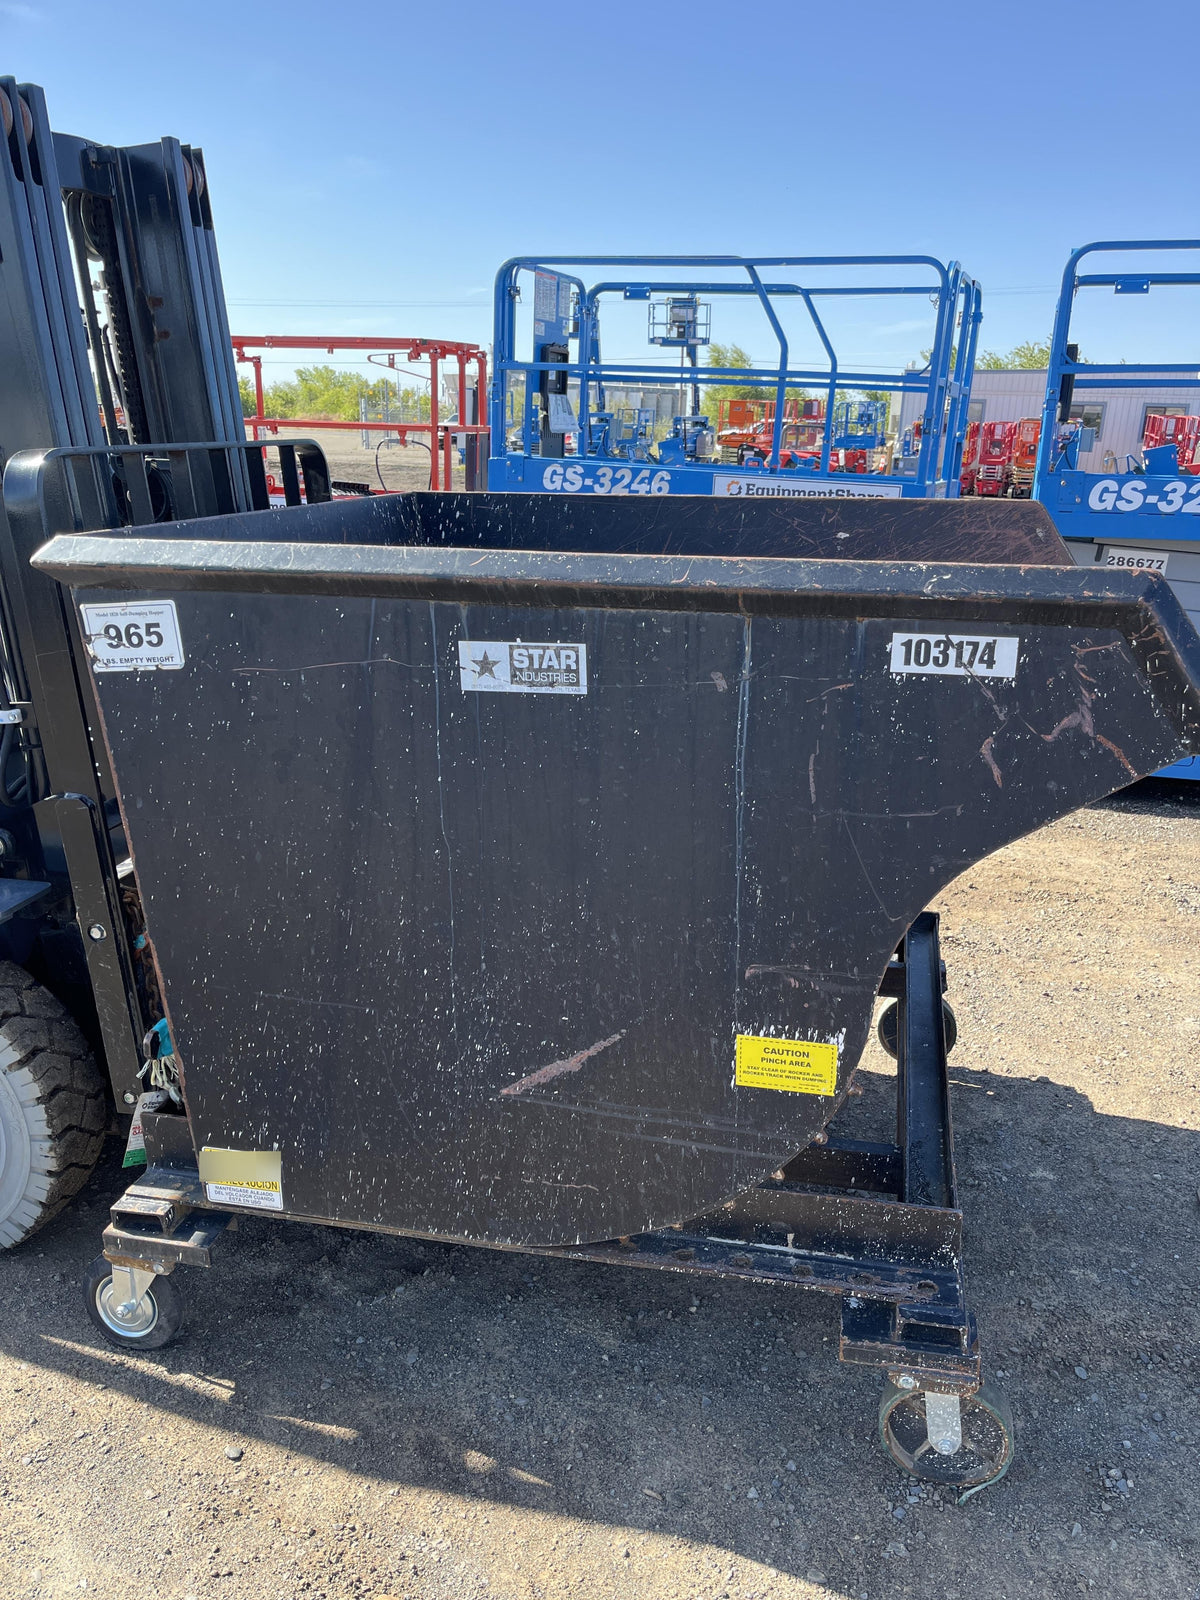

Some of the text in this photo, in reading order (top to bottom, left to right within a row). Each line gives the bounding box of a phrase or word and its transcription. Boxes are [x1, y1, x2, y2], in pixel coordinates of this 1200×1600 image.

[542, 464, 671, 495] GS-3246
[1088, 479, 1200, 513] GS-32
[1107, 555, 1165, 570] 286677
[103, 622, 164, 649] 965
[512, 648, 577, 670] STAR
[900, 638, 998, 670] 103174
[515, 671, 577, 683] NDUSTRIES
[763, 1047, 810, 1059] CAUTION
[761, 1057, 812, 1068] PINCH AREA
[225, 1191, 254, 1200] VOLCADOR
[254, 1195, 275, 1203] CUANDO
[250, 1190, 274, 1198] ALEJADO
